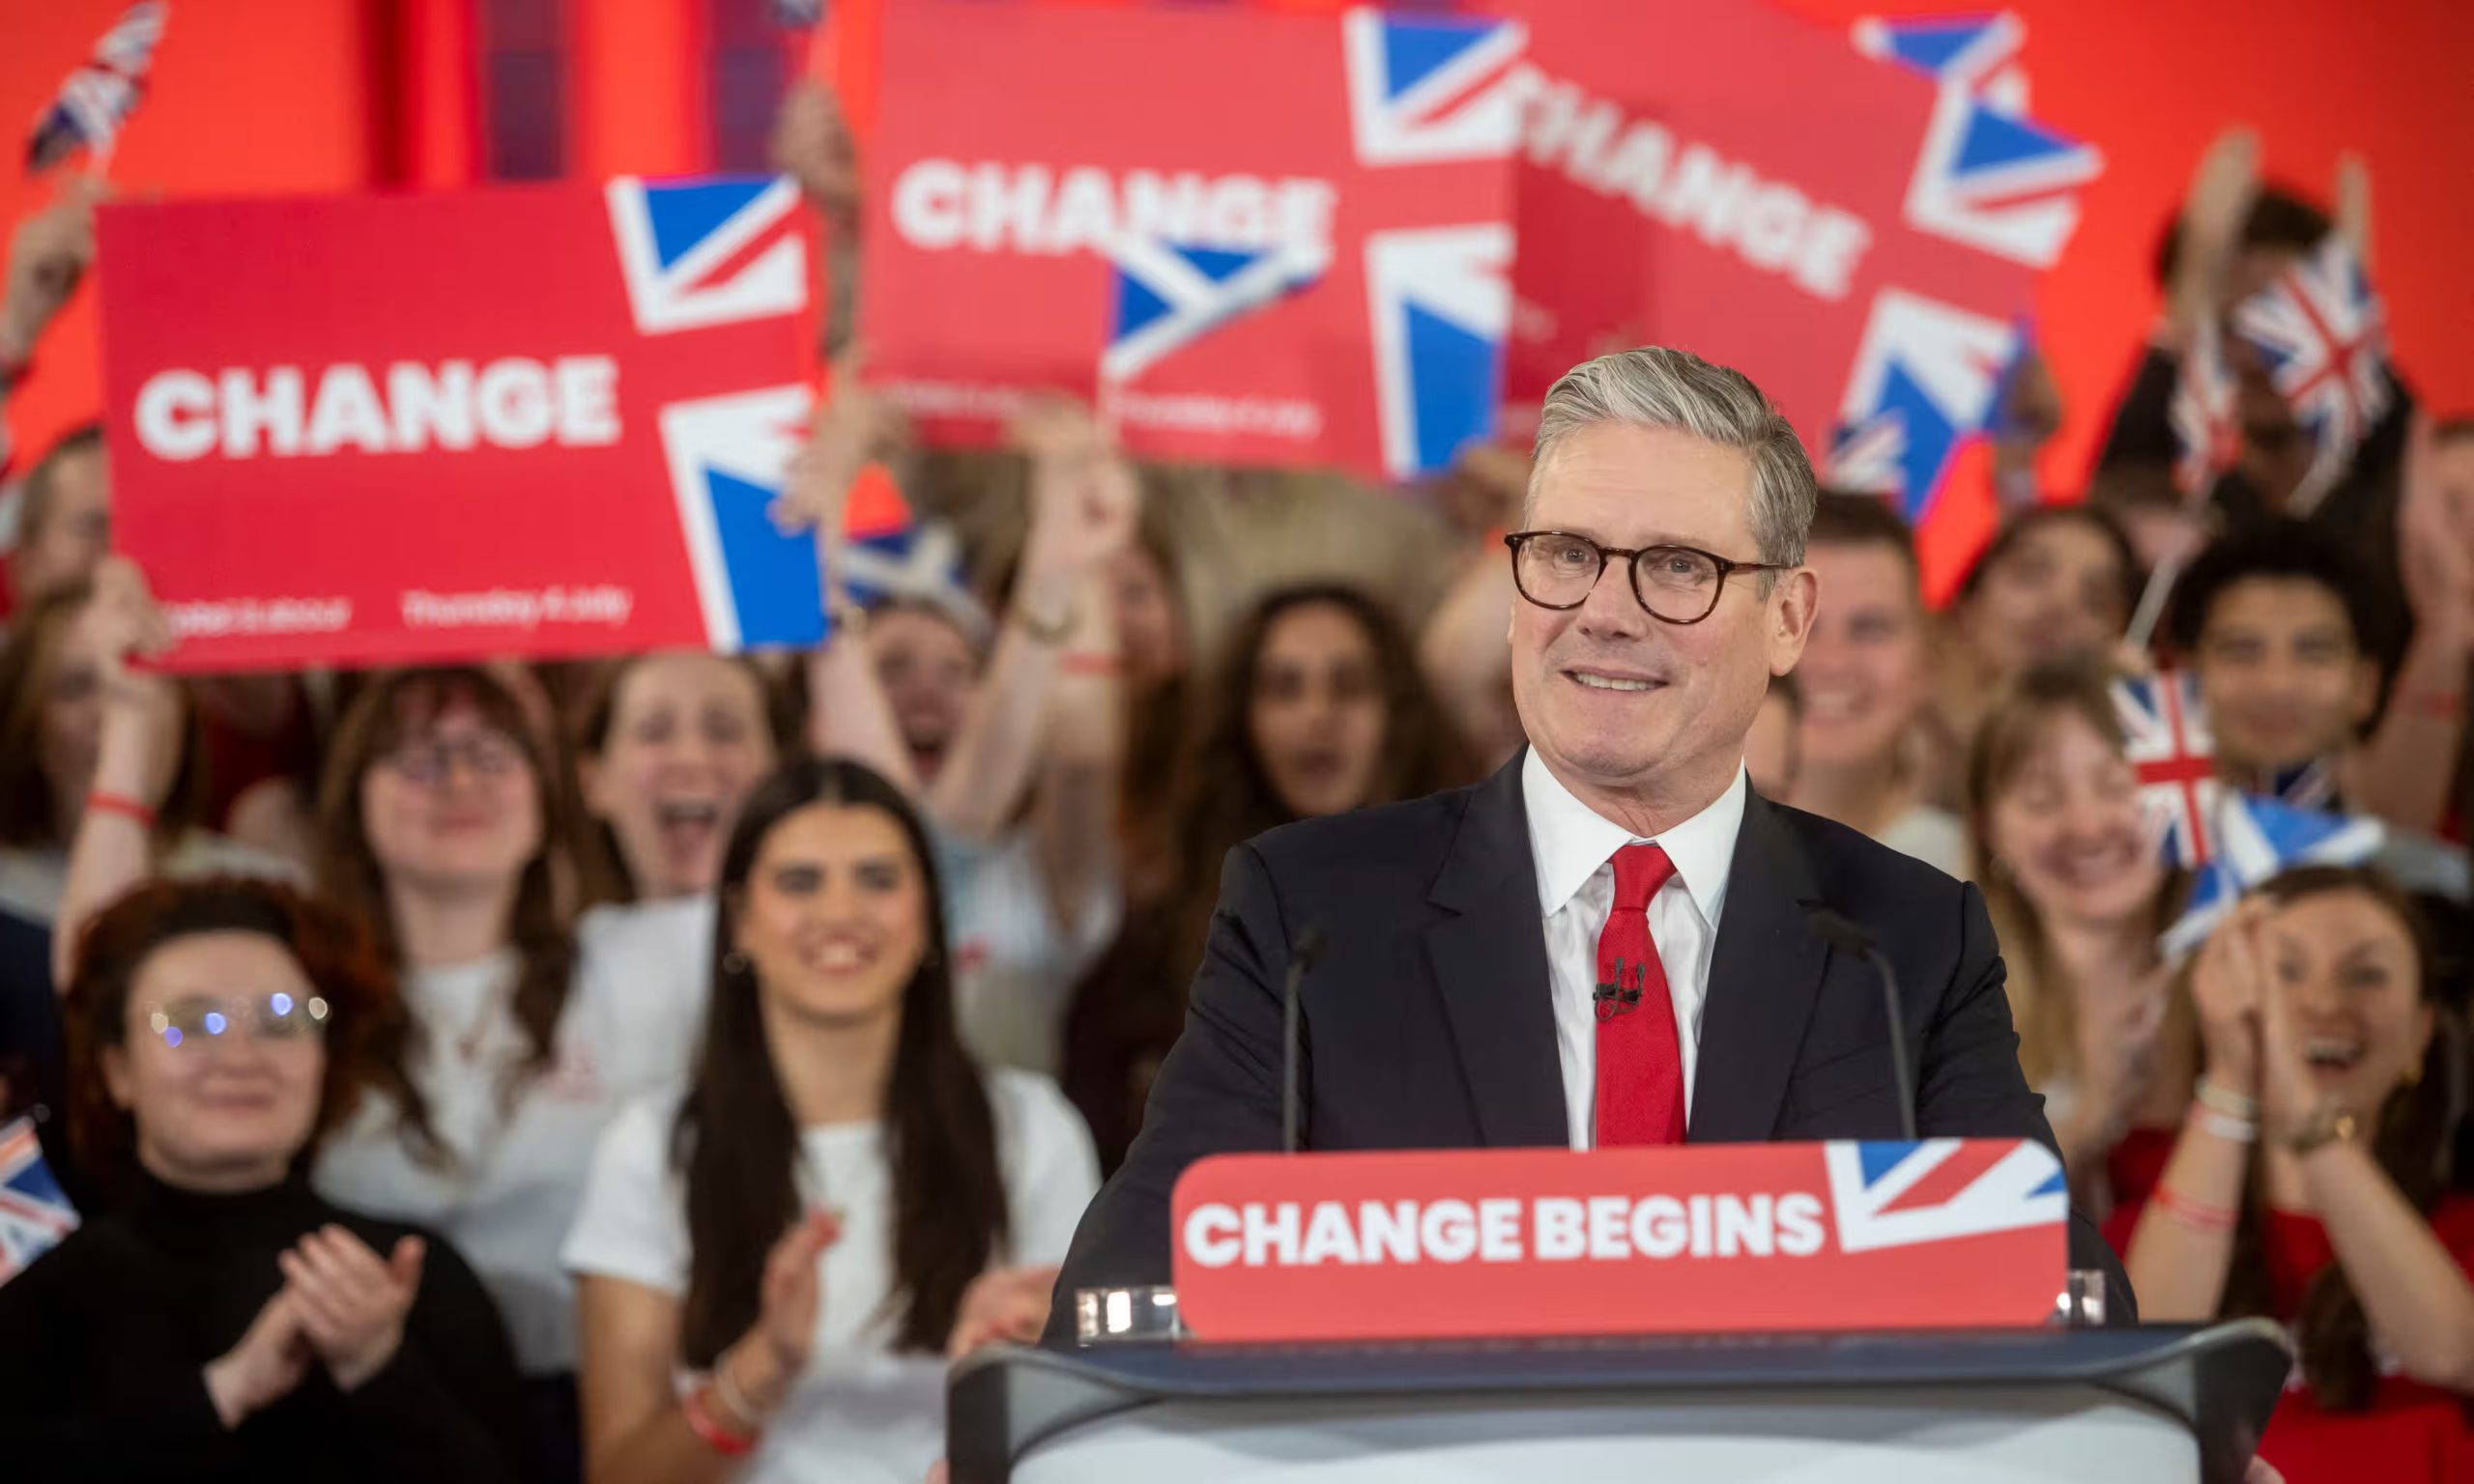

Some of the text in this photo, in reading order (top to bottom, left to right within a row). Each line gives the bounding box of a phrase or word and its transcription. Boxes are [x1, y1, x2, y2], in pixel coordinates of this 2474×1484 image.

[891, 158, 1337, 259] CHANGE
[134, 355, 622, 461] CHANGE
[1184, 1192, 1825, 1268] CHANGE BEGINS
